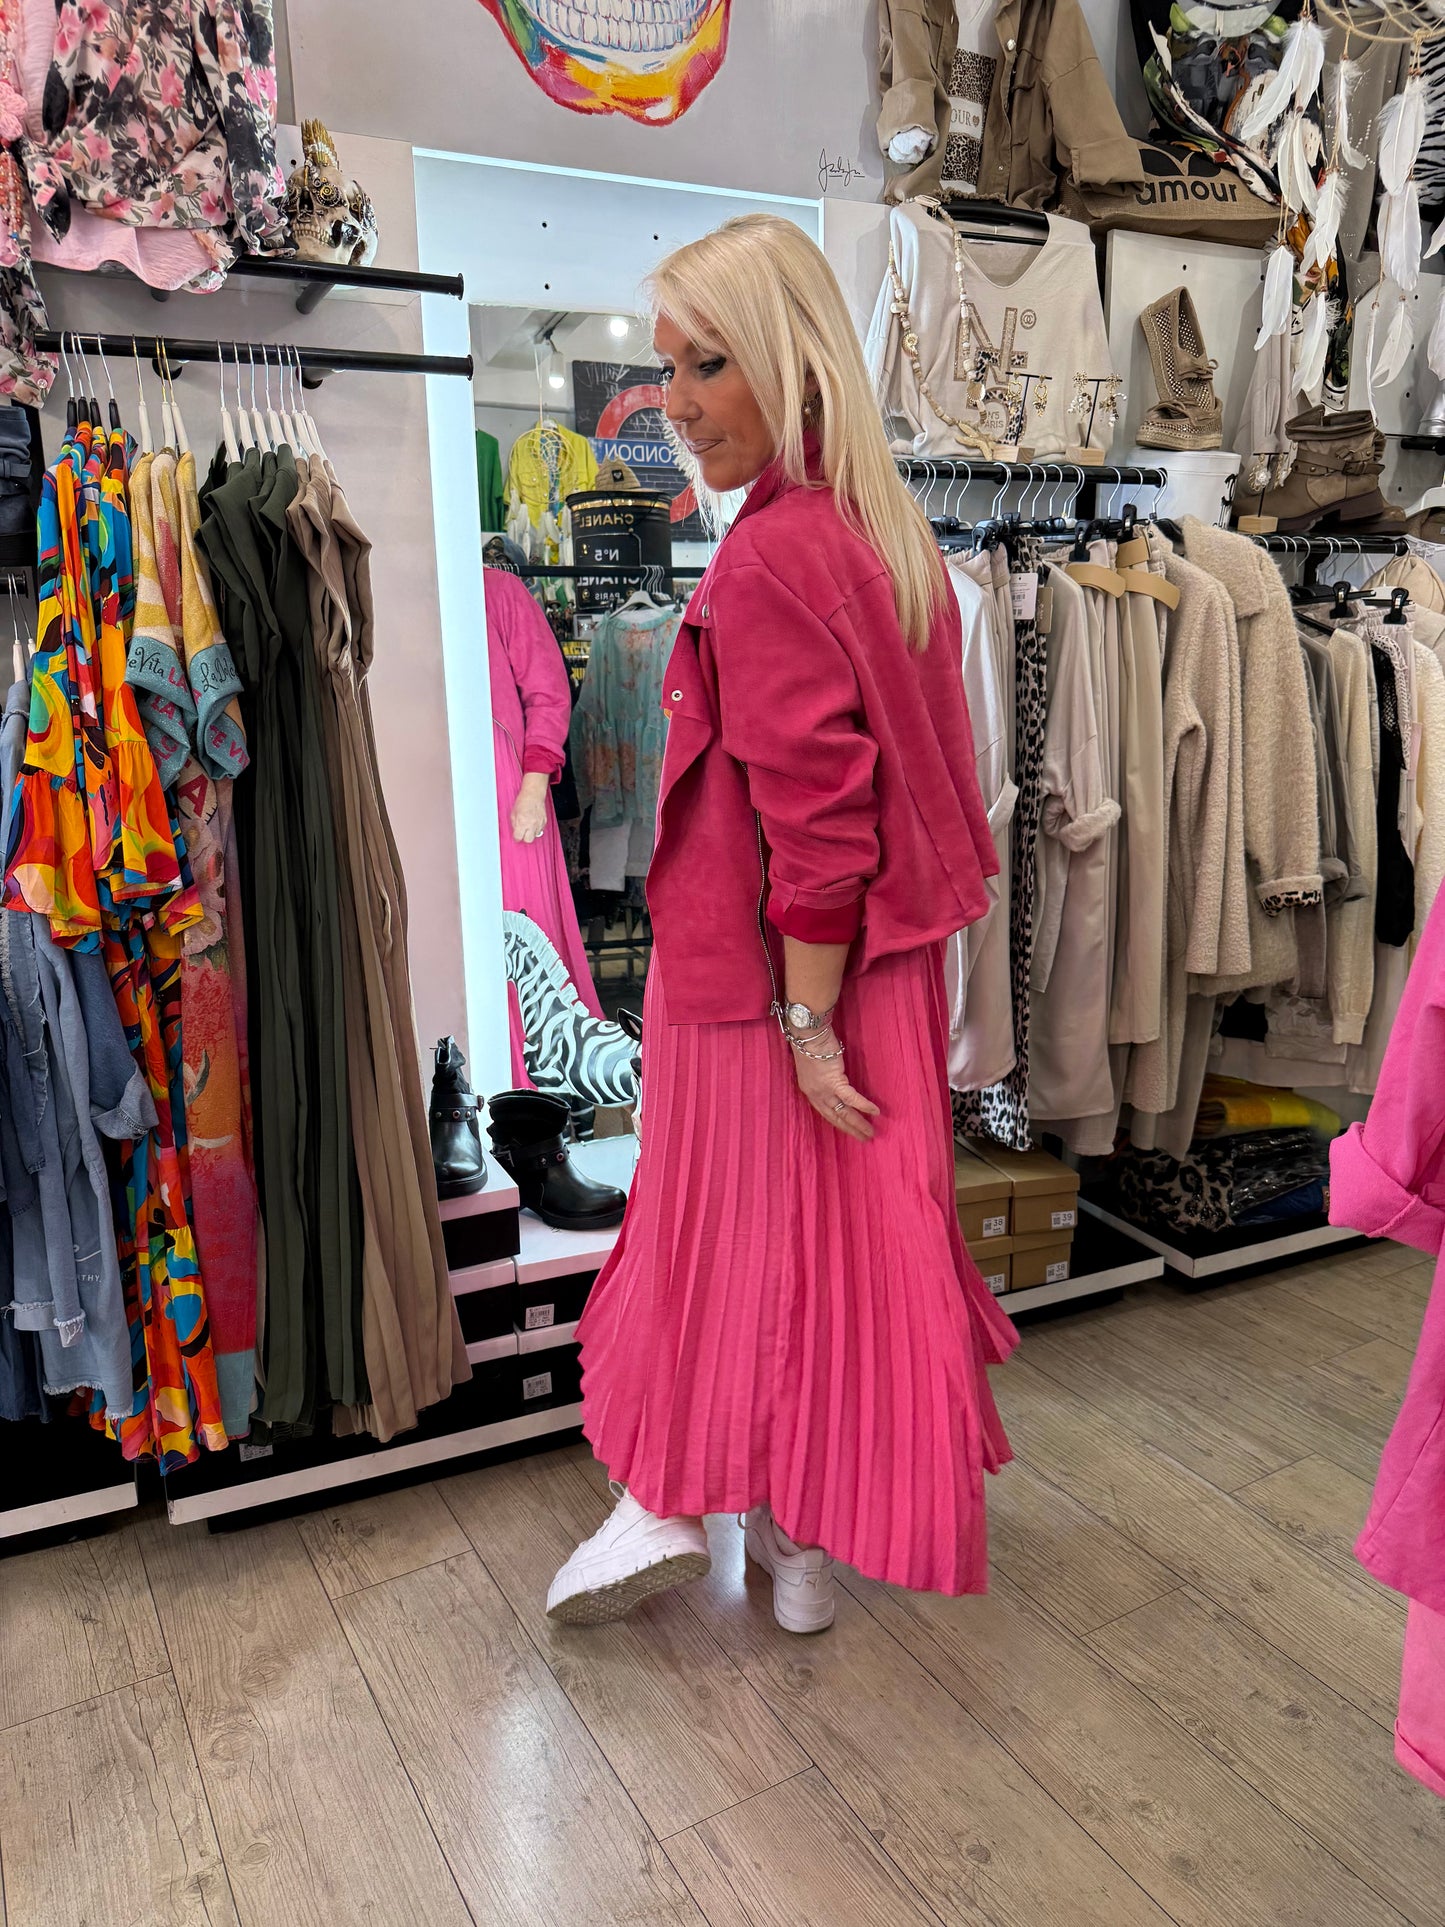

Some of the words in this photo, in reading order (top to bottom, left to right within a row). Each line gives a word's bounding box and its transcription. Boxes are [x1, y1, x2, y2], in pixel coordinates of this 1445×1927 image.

[950, 108, 971, 126] OUR
[1136, 180, 1237, 206] amour
[984, 420, 1004, 429] ARIS
[1062, 1213, 1073, 1221] 39
[81, 1274, 102, 1283] THY.
